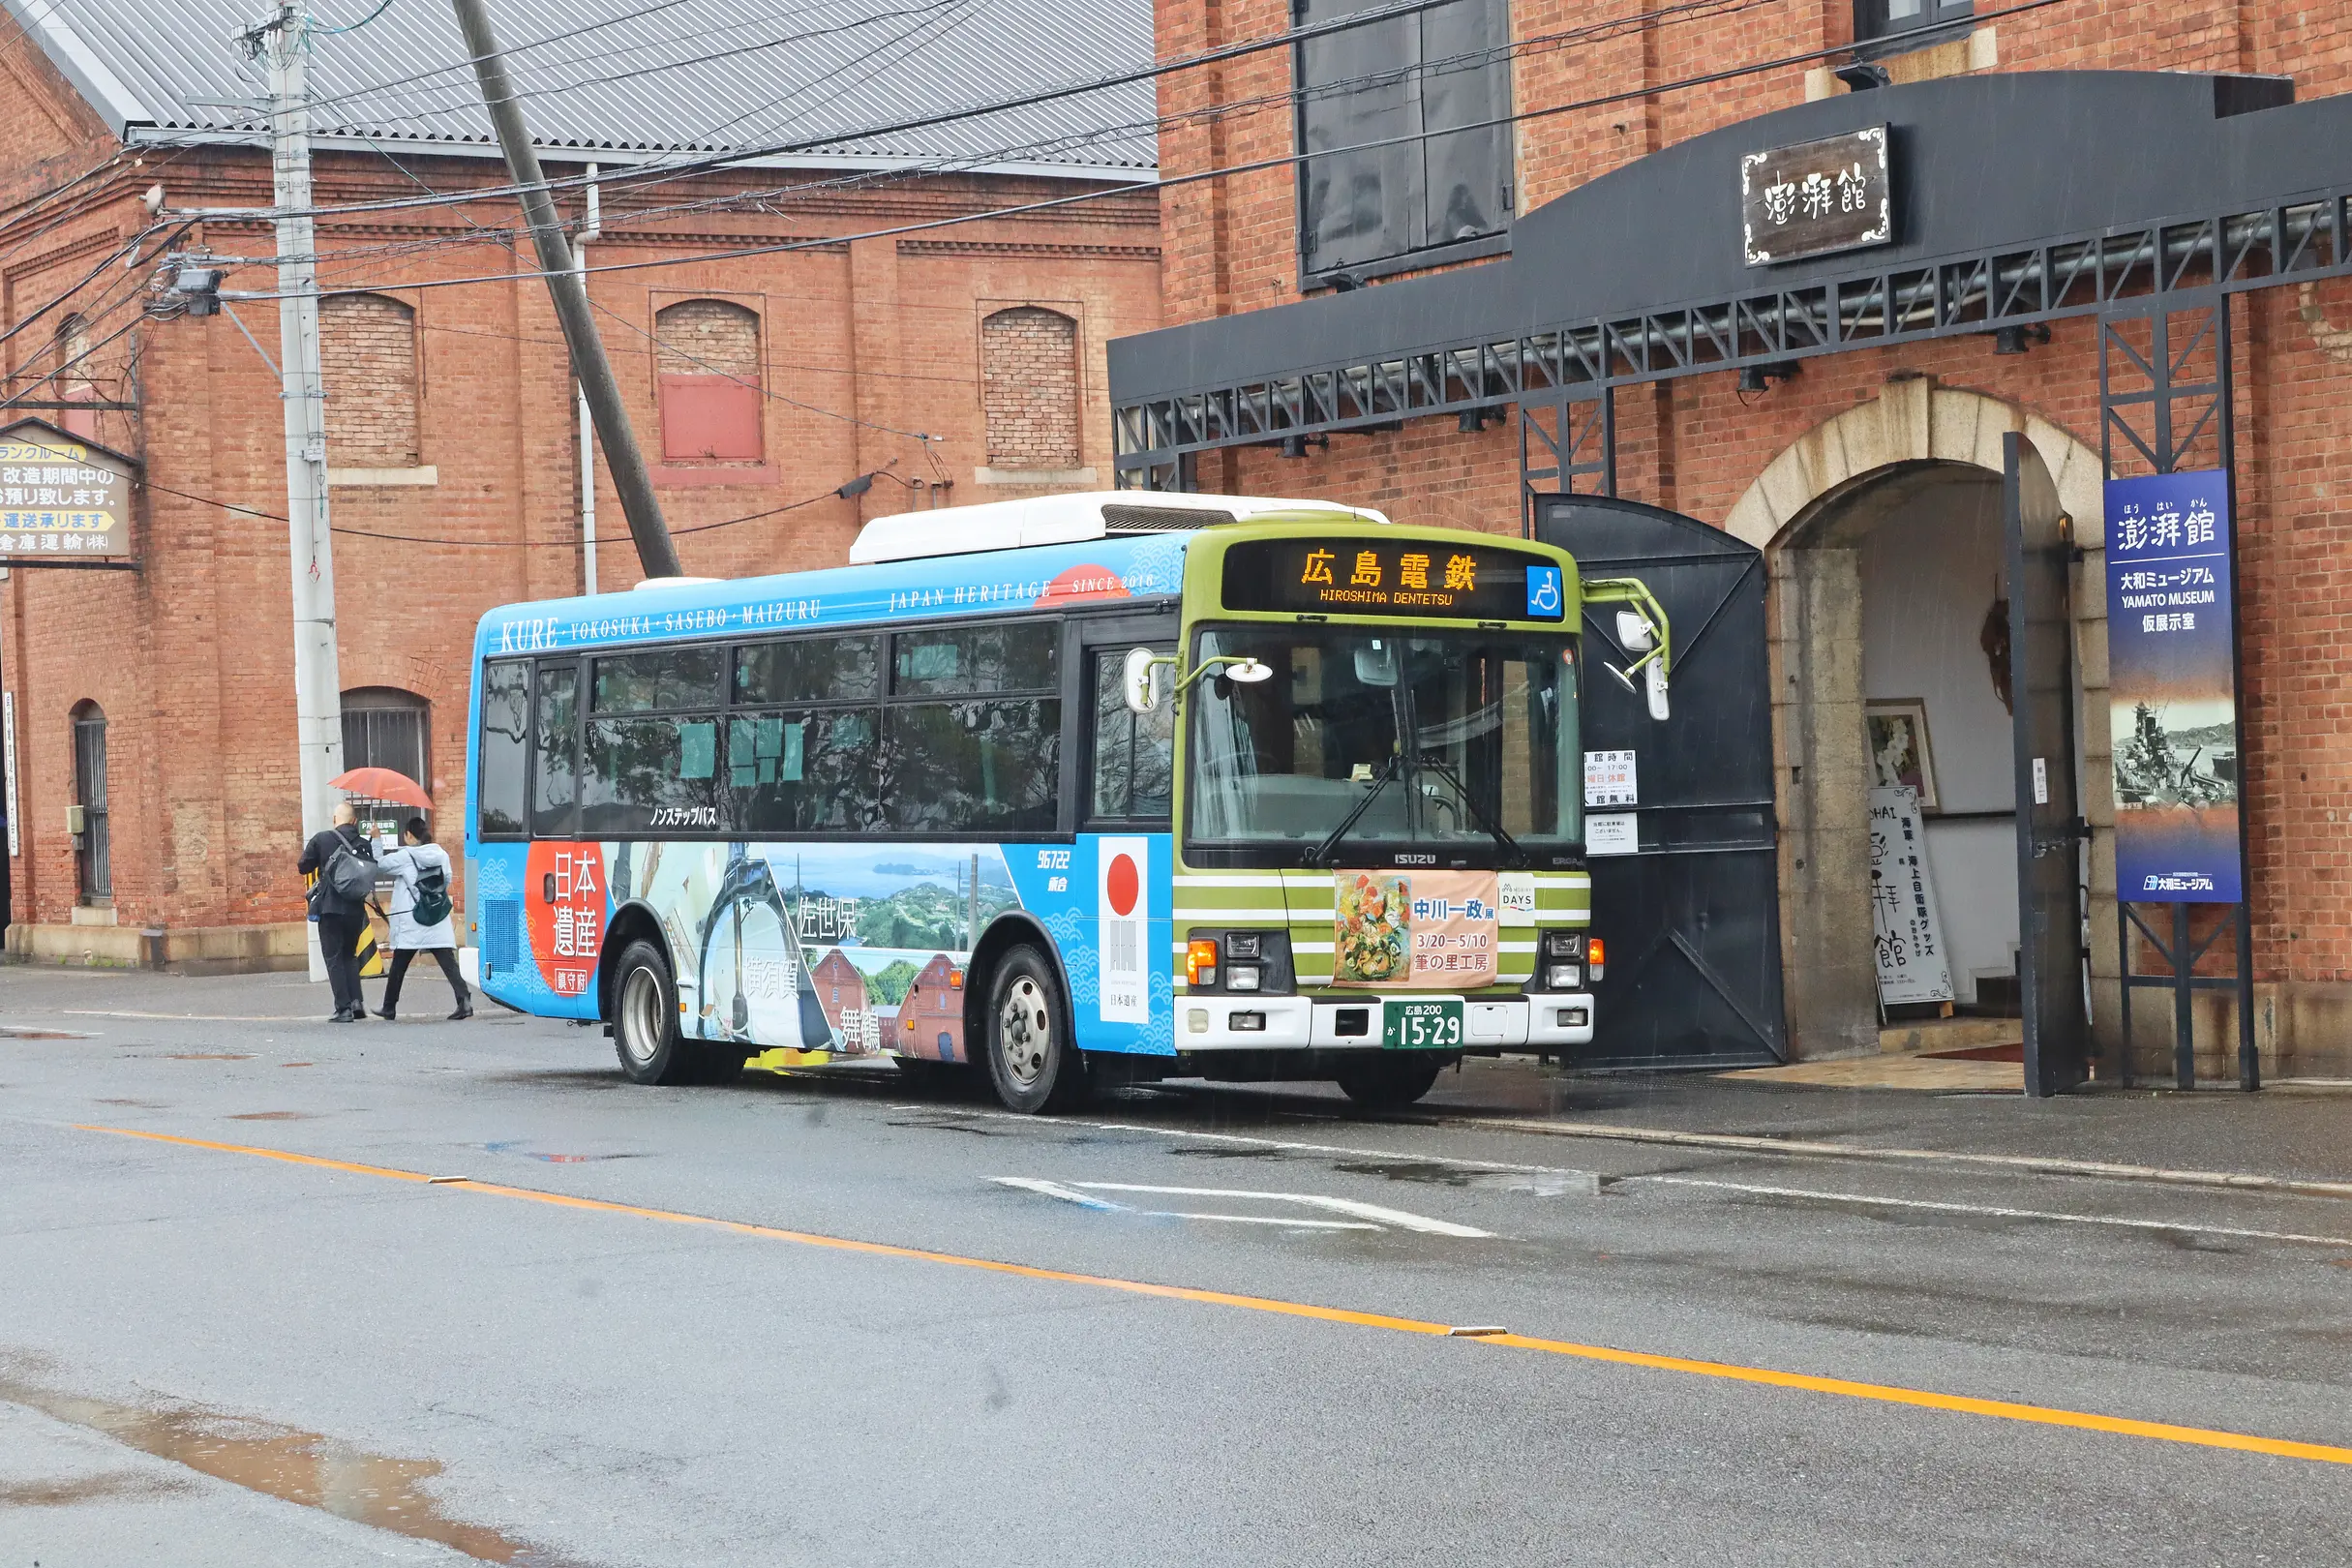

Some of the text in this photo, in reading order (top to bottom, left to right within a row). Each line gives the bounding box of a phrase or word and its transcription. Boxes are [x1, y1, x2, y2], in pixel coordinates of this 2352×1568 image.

[1764, 162, 1866, 225] 澎湃館
[3, 467, 114, 485] 改造期間中の
[2118, 509, 2215, 550] 澎湃館
[1301, 548, 1476, 591] 広島電鉄
[2121, 567, 2215, 590] 大和ミュージアム
[889, 573, 1155, 613] JAPAN HERITAGE SINCE 2016
[1320, 588, 1452, 606] HIROSHIMA DENTETSU
[2121, 589, 2215, 609] YAMATO MUSEUM
[499, 598, 822, 652] KURE YOKOSUKA SASEBO MAIZURU
[2142, 612, 2195, 633] 仮展示室
[650, 806, 717, 826] ノンステップバス
[1037, 850, 1070, 869] 96722
[1395, 855, 1436, 864] ISUZU
[554, 850, 597, 902] 日本
[2158, 877, 2214, 890] 大和ミュージアム
[1413, 898, 1494, 920] 中川一政展
[1503, 895, 1532, 905] DAYS
[798, 895, 857, 940] 佐世保
[553, 906, 597, 958] 遺産
[1415, 953, 1489, 972] 筆の里工房
[558, 972, 587, 992] 鎮守府
[744, 955, 799, 1000] 横須賀
[1110, 994, 1137, 1007] 日本遺産
[840, 1006, 881, 1053] 舞鶴
[1386, 1016, 1460, 1045] か 15-29
